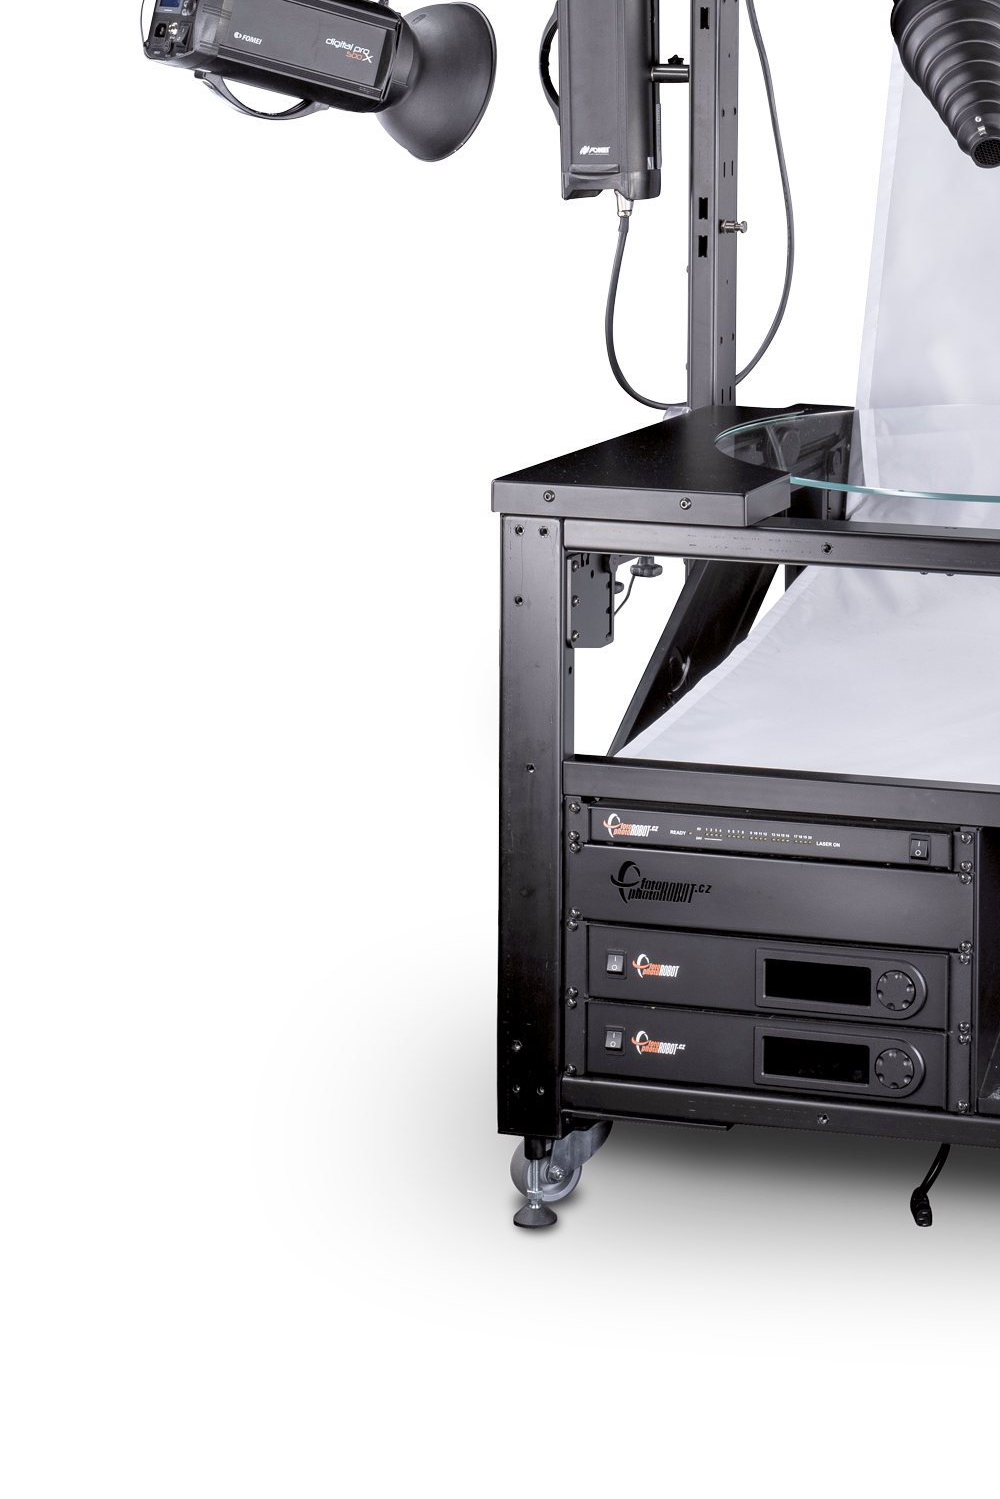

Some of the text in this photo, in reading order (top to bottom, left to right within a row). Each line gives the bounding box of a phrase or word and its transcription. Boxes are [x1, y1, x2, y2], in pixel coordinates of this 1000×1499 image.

[241, 34, 263, 45] FOMEI
[325, 37, 371, 57] digital pro
[659, 964, 680, 978] ROBOT
